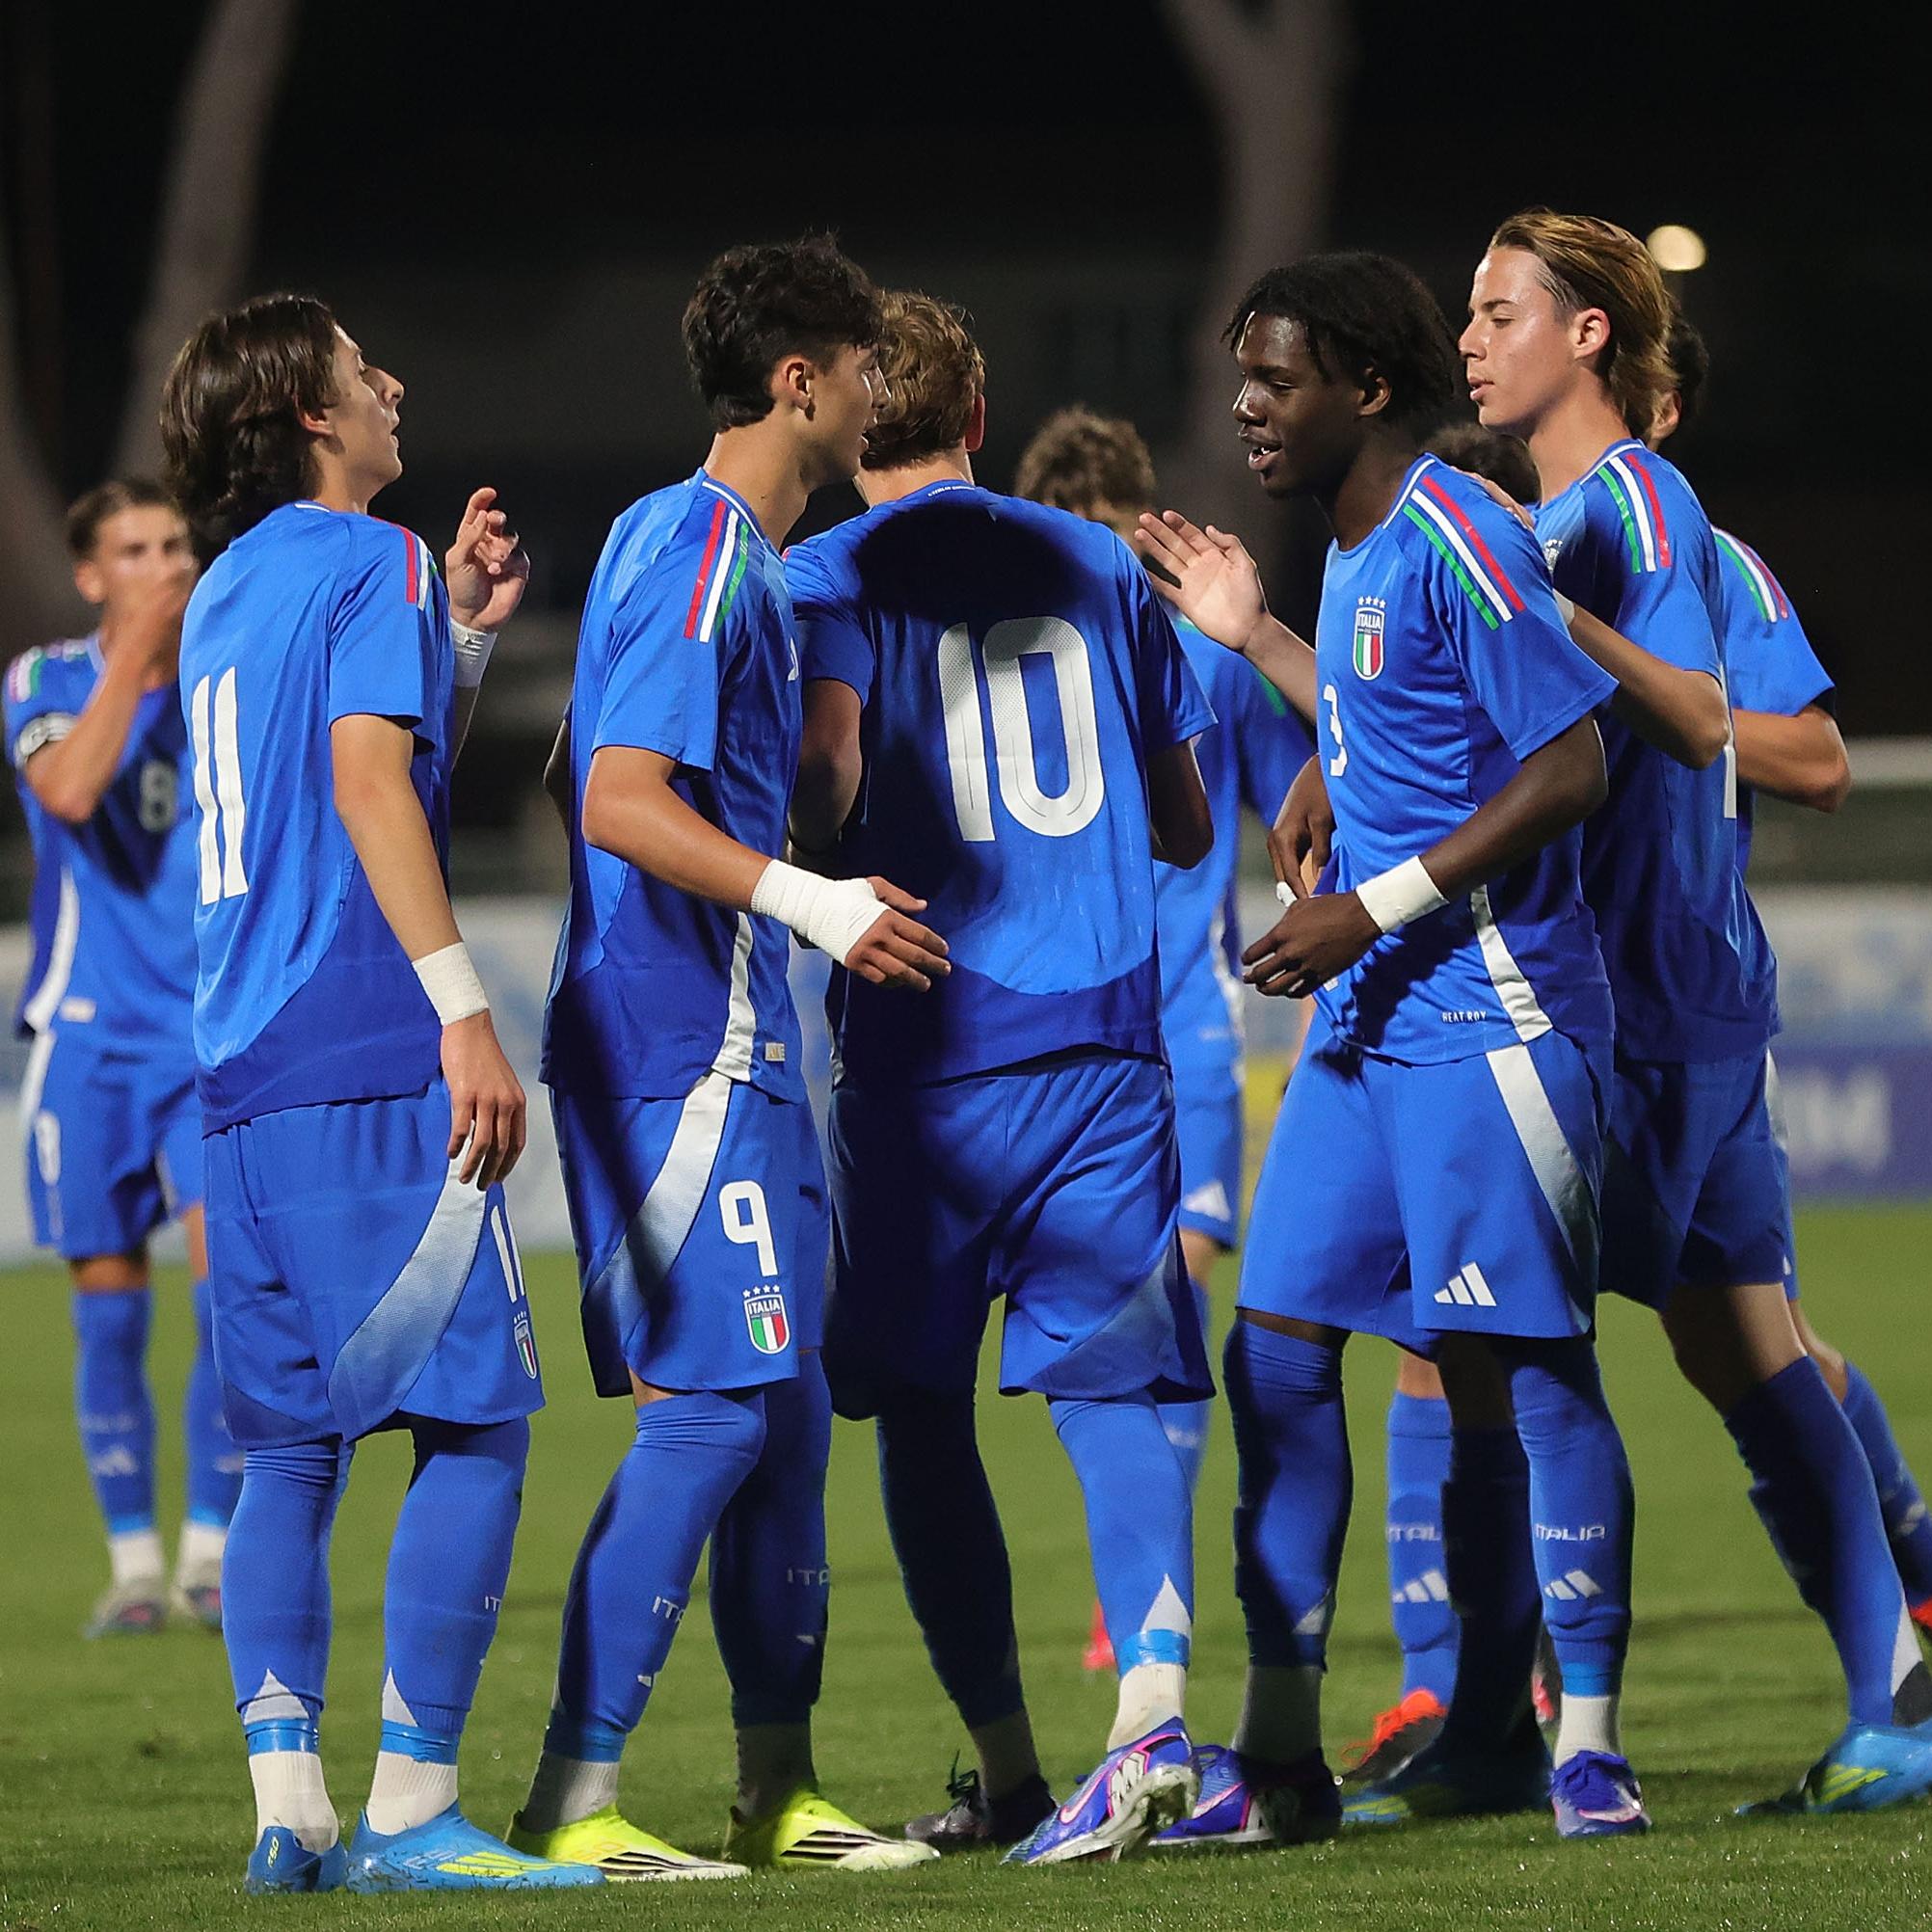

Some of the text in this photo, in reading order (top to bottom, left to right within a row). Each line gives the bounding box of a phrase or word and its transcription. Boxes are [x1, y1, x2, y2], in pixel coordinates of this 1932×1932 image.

[1357, 613, 1382, 630] ITALIA
[938, 616, 1105, 842] 10
[1324, 684, 1348, 777] 3
[140, 759, 176, 831] 8
[192, 666, 250, 906] 11
[719, 1180, 778, 1276] 9
[748, 1299, 781, 1314] ITALIA
[1536, 1523, 1605, 1542] ITALIA
